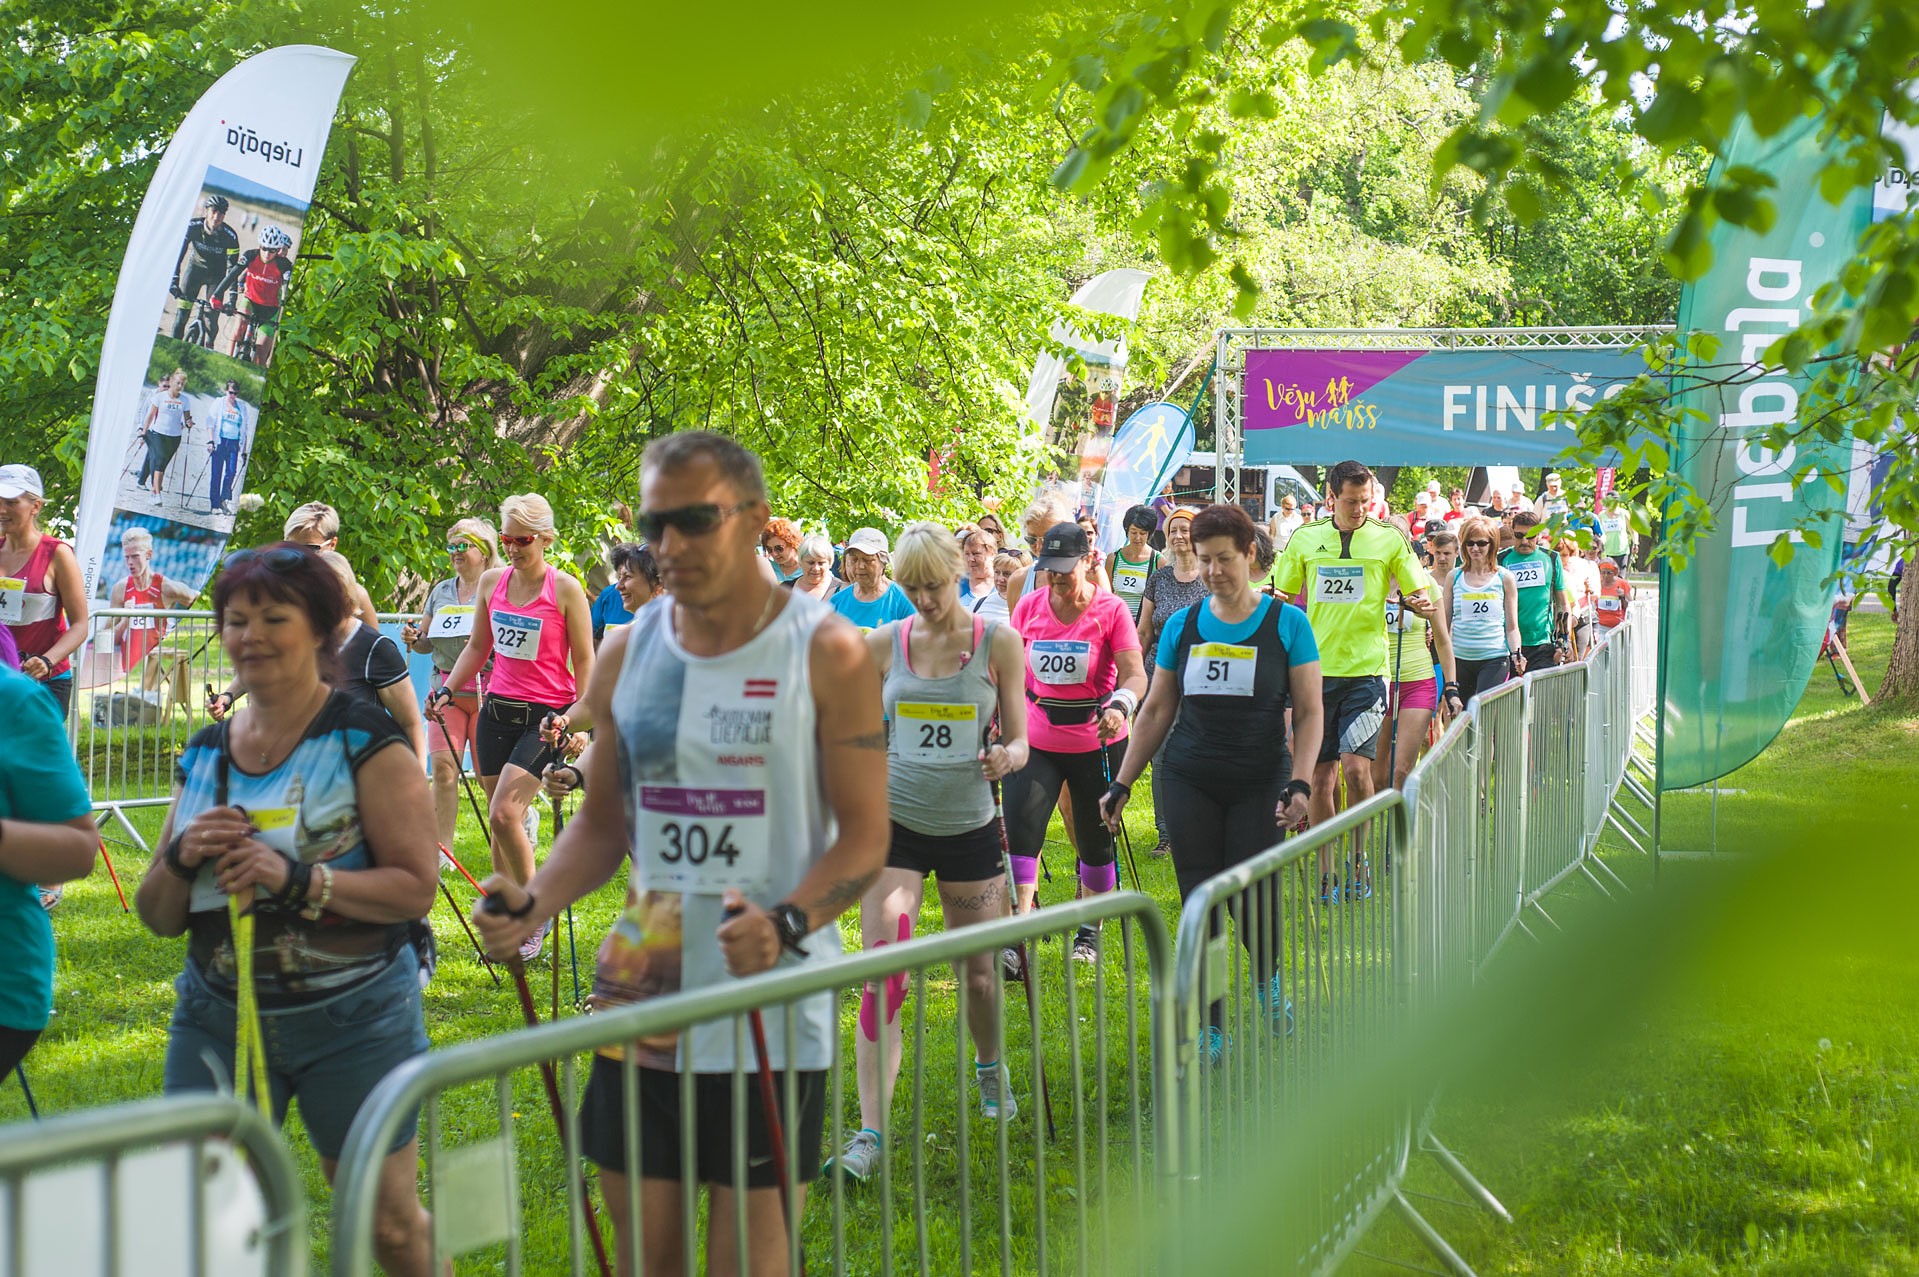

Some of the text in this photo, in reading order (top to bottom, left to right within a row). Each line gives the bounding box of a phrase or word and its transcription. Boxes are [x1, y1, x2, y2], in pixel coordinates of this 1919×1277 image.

[1263, 378, 1320, 420] Vēju
[1306, 399, 1383, 430] maršs
[1123, 576, 1137, 588] 52
[1516, 569, 1538, 582] 223
[1323, 579, 1354, 594] 224
[1472, 602, 1489, 614] 26
[442, 616, 462, 630] 67
[497, 626, 528, 649] 227
[1039, 655, 1077, 673] 208
[1206, 660, 1229, 681] 51
[919, 723, 953, 749] 28
[659, 822, 741, 868] 304
